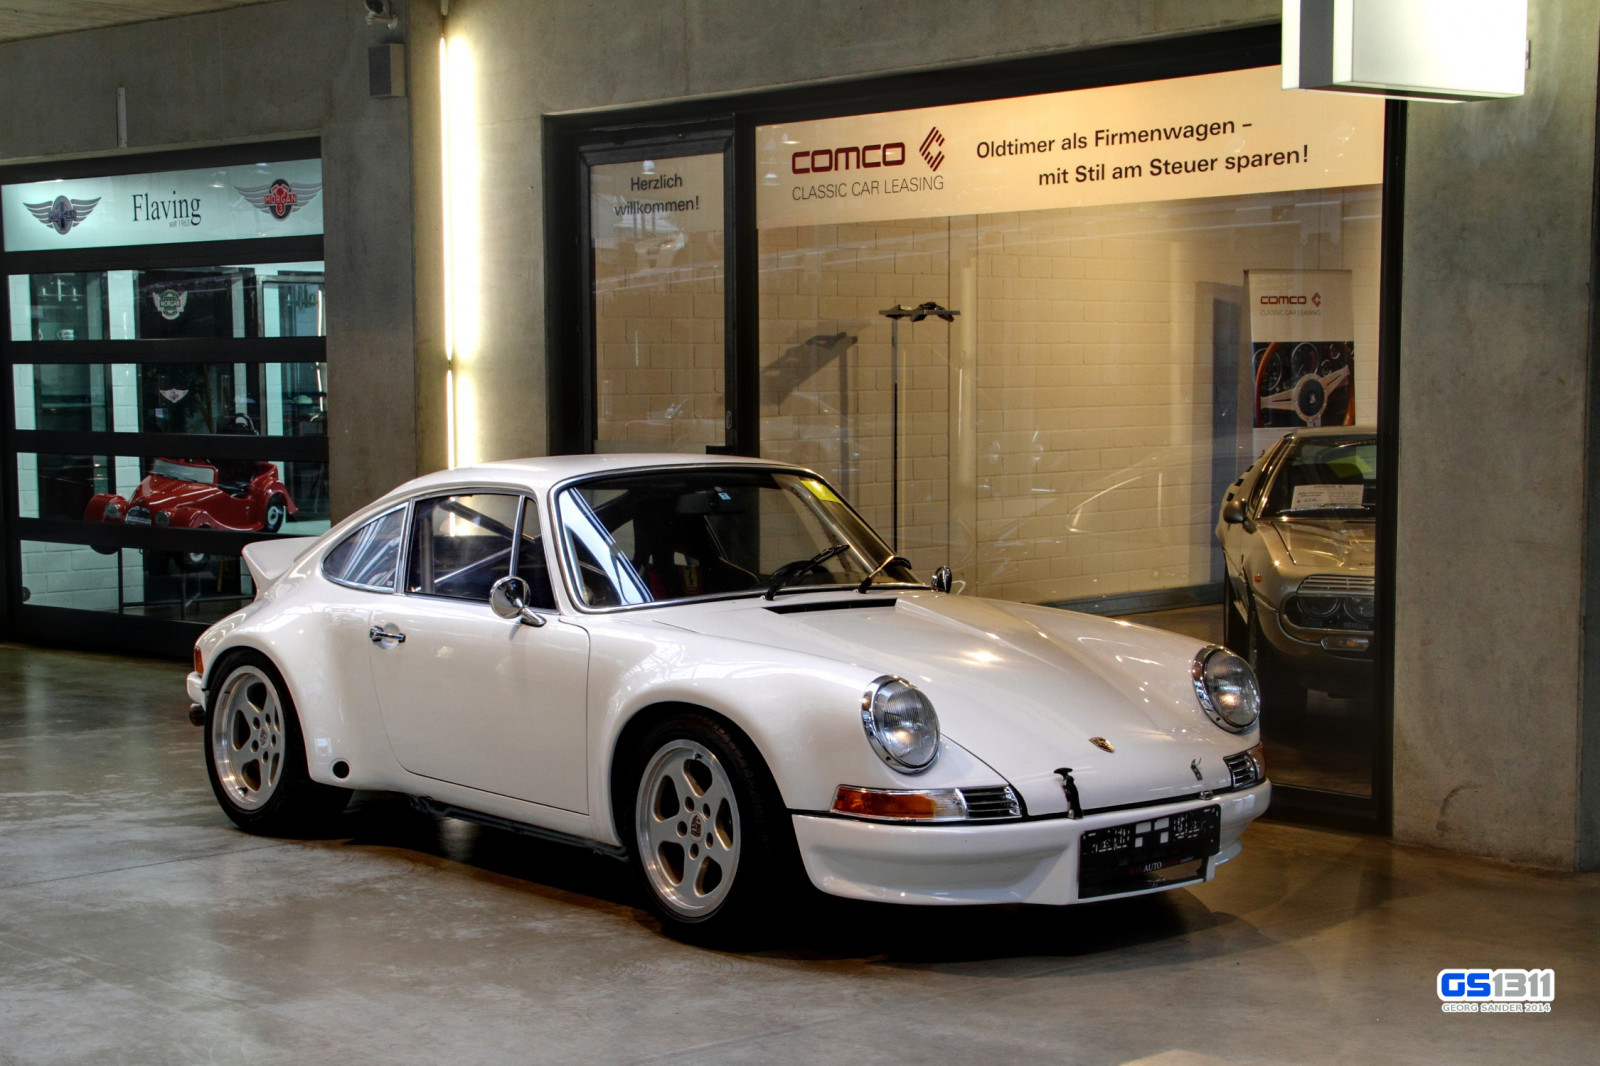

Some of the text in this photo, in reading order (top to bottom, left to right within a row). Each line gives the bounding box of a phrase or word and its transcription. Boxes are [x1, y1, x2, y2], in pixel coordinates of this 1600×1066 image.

[976, 138, 1056, 159] Oldtimer
[1061, 132, 1088, 151] als
[1095, 120, 1235, 147] Firmenwagen
[1038, 144, 1308, 186] mit Stil am Steuer sparen!
[630, 173, 683, 191] Herzlich
[792, 174, 945, 201] CLASSIC CAR LEASING
[132, 189, 202, 226] Flaving
[264, 193, 297, 205] MORGAN
[278, 204, 284, 213] 3
[614, 196, 699, 216] willkommen!
